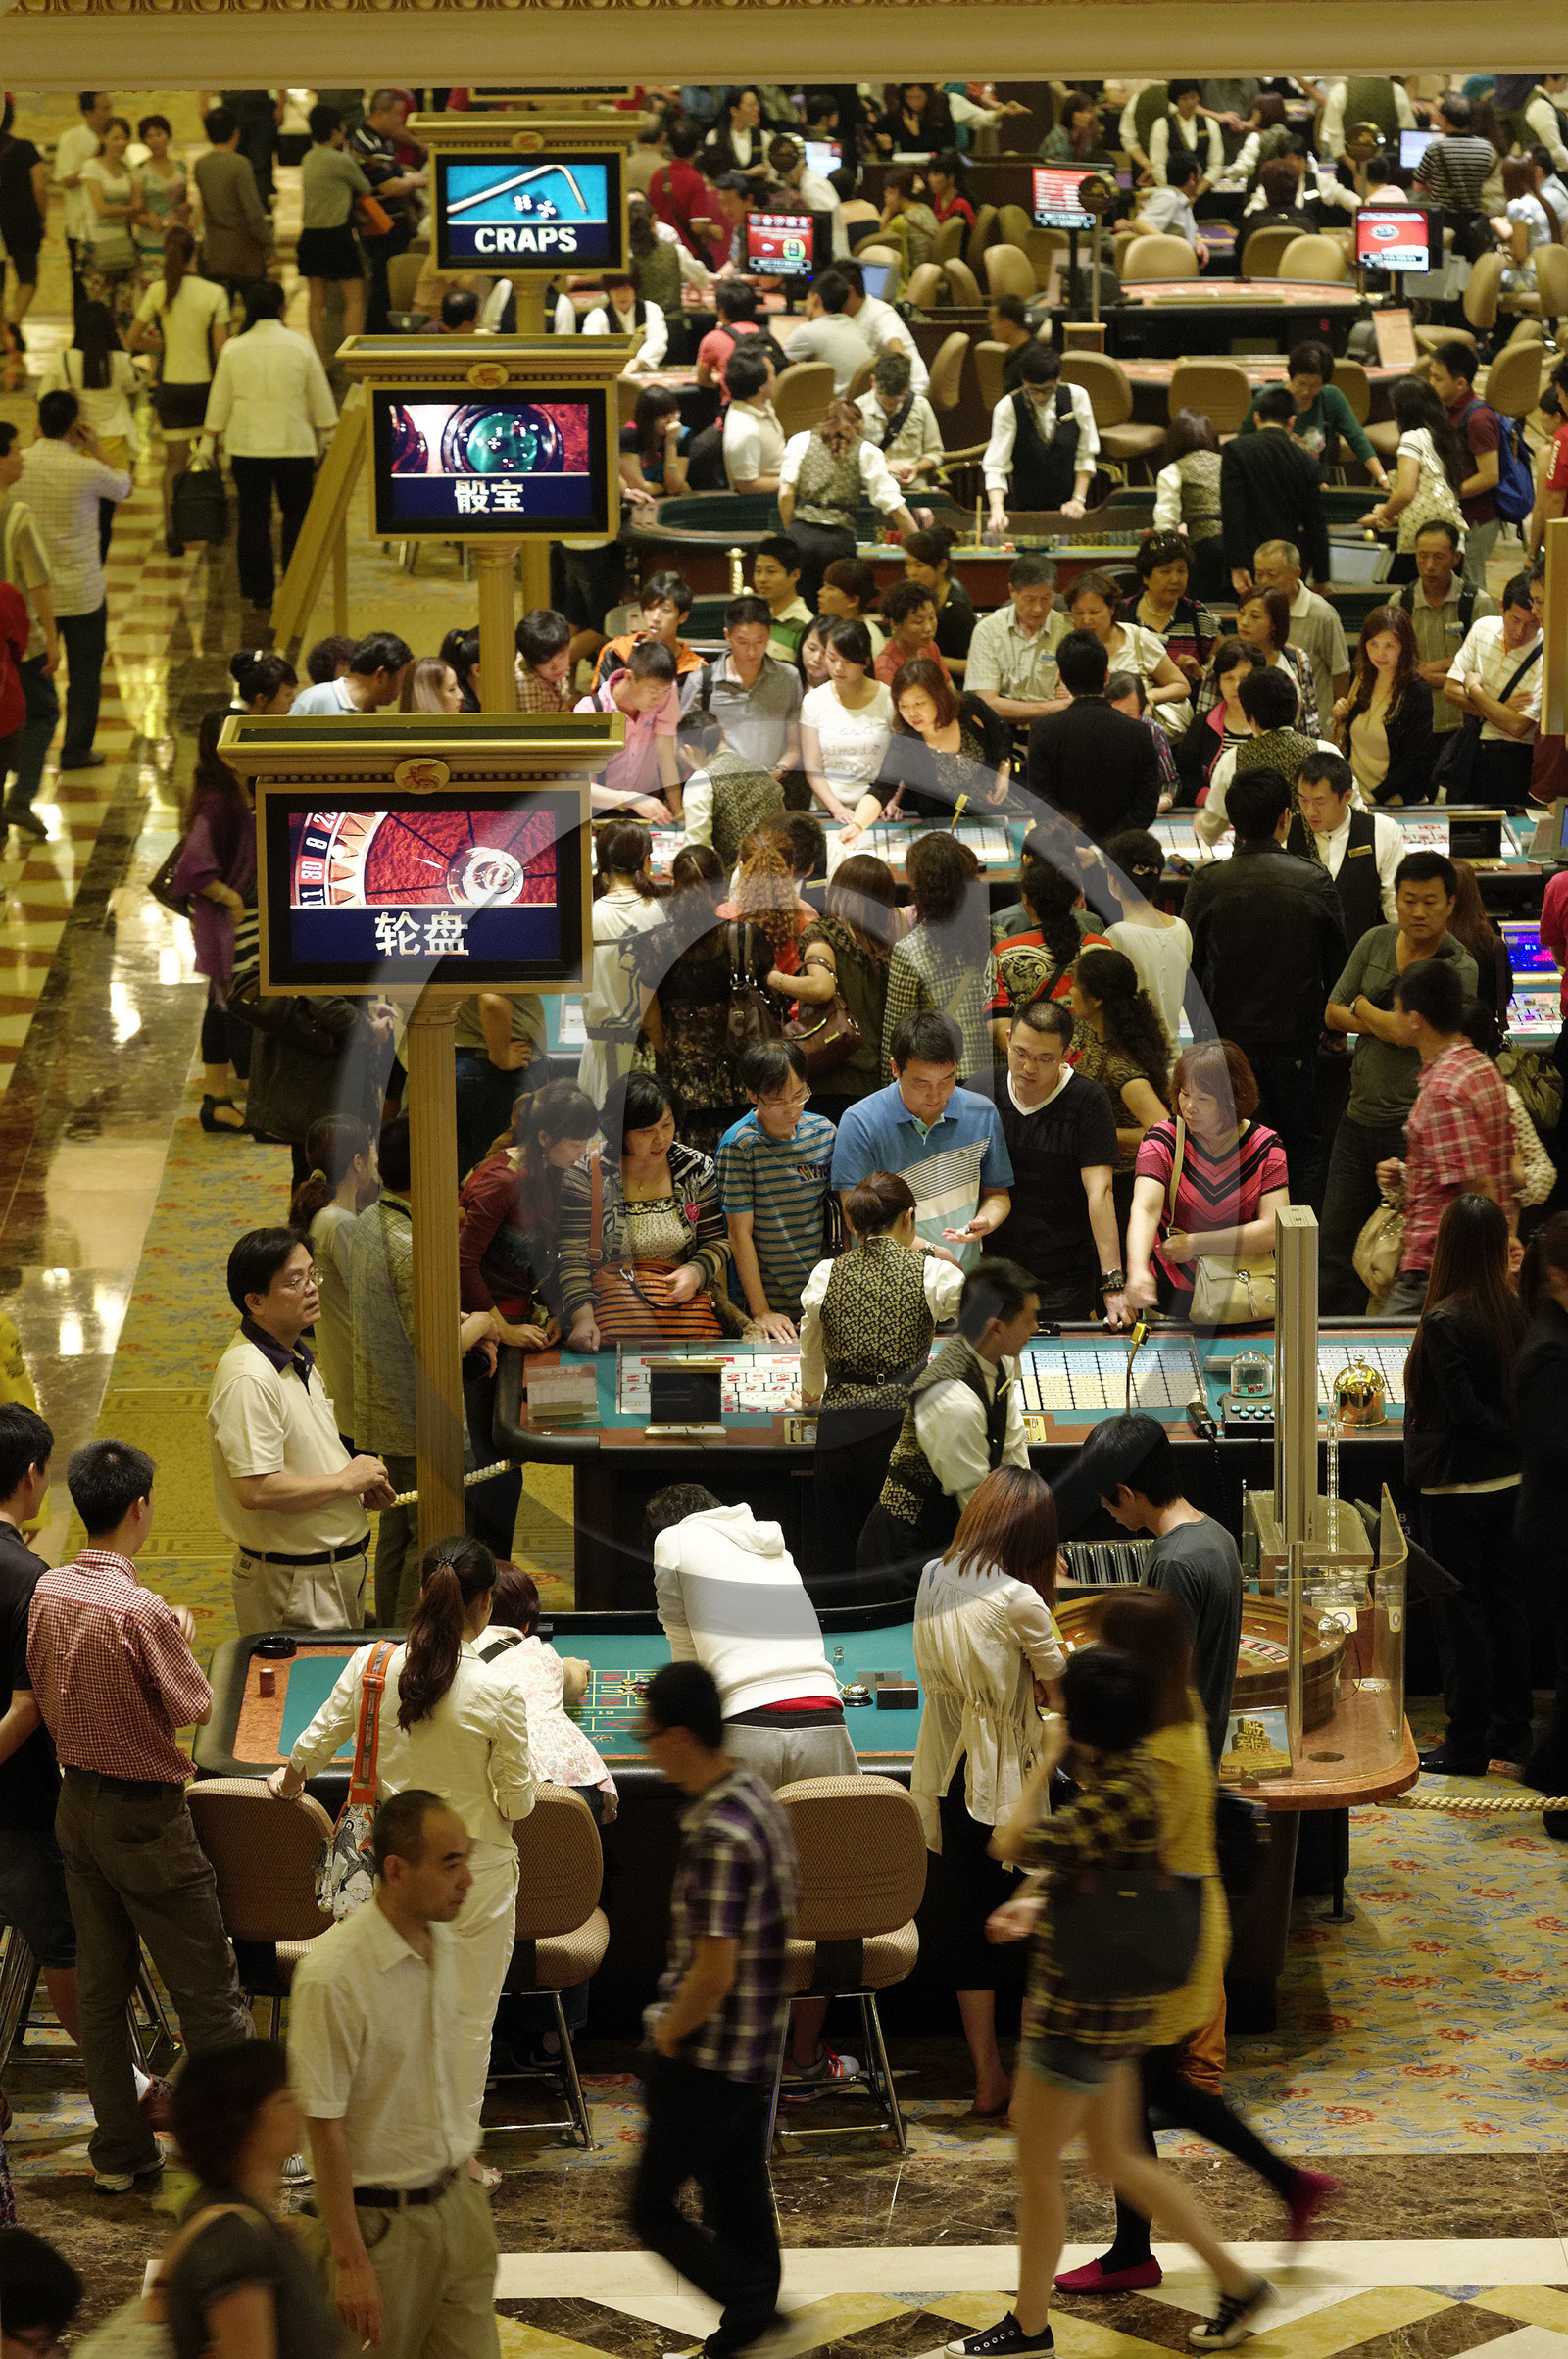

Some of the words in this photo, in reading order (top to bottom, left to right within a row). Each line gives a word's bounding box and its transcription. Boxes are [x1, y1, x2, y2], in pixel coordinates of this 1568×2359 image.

[474, 226, 578, 254] CRAPS
[454, 478, 525, 514] 骰宝
[305, 836, 328, 850] 8
[301, 860, 323, 880] 30
[374, 910, 470, 957] 轮盘
